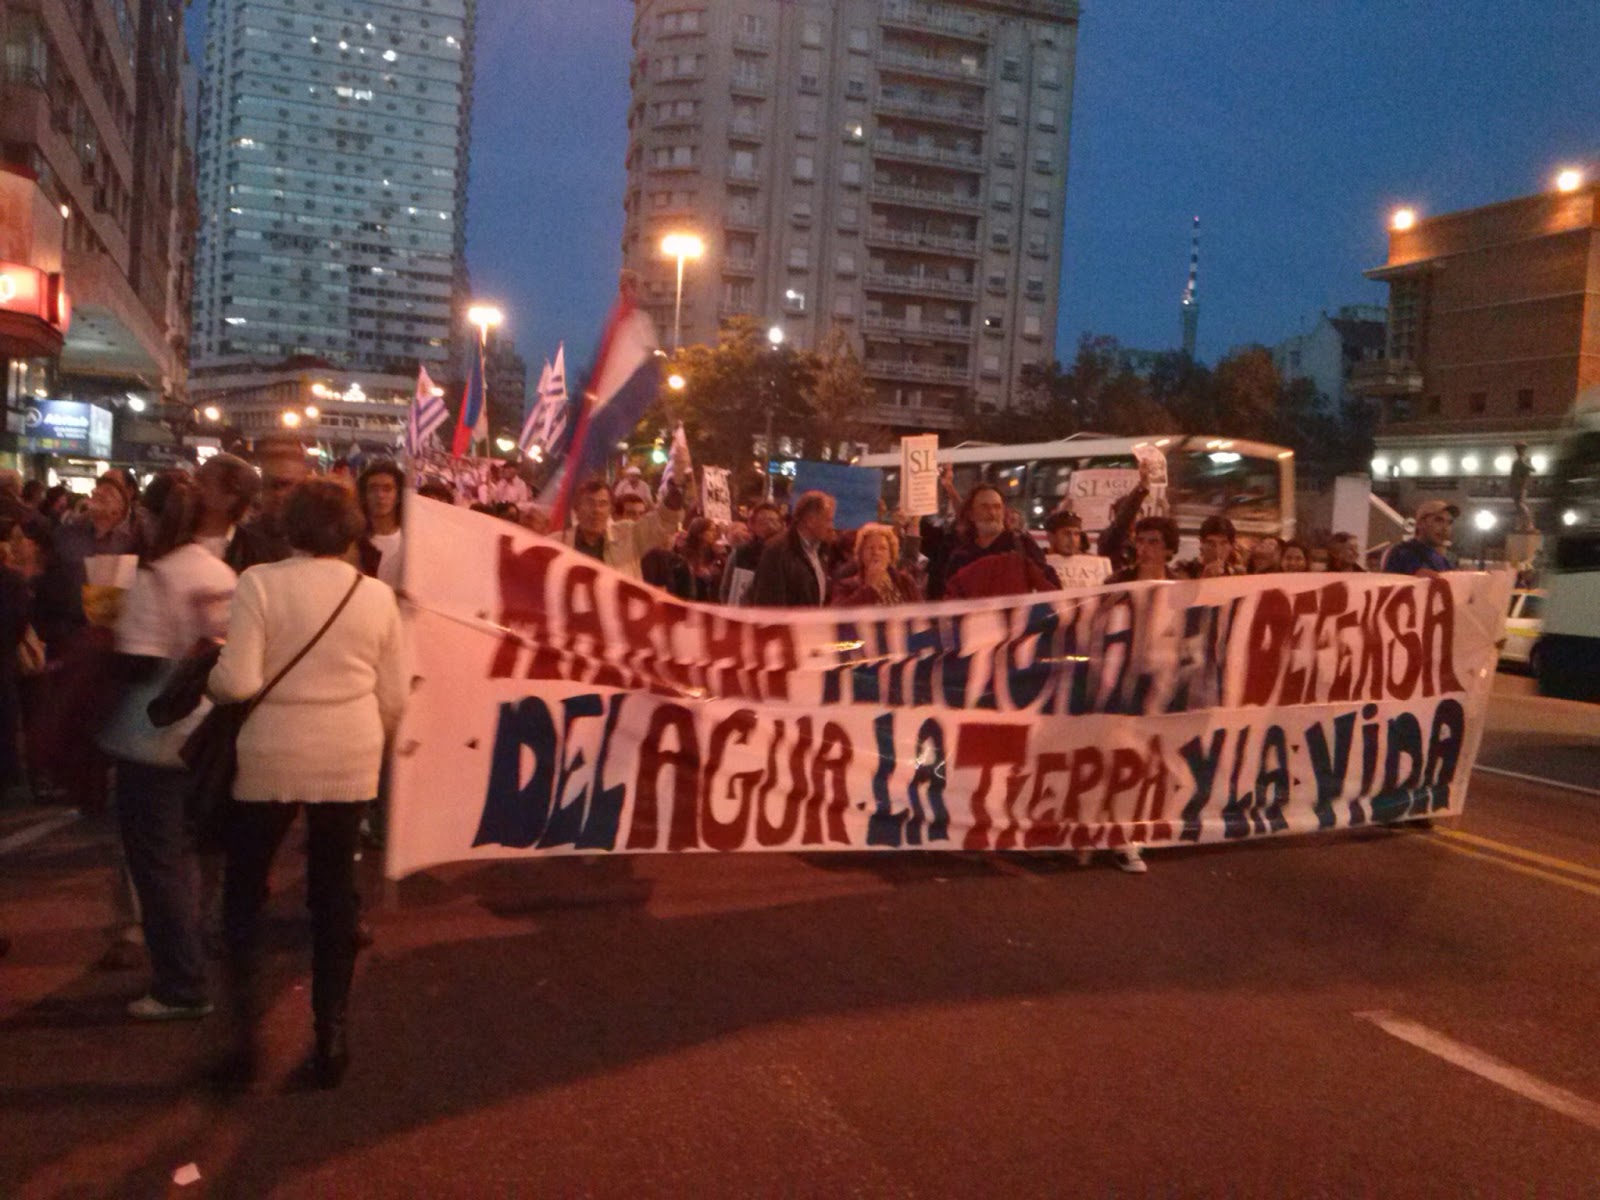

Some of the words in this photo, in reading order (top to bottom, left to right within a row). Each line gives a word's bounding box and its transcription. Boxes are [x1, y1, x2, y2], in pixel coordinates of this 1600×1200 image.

[490, 534, 799, 701] MARCHA
[1242, 576, 1467, 708] DEFENSA
[472, 692, 628, 850] DEL
[625, 701, 852, 852] AGUA
[866, 712, 951, 848] LA
[1178, 726, 1227, 843] Y
[1221, 723, 1290, 839] LA
